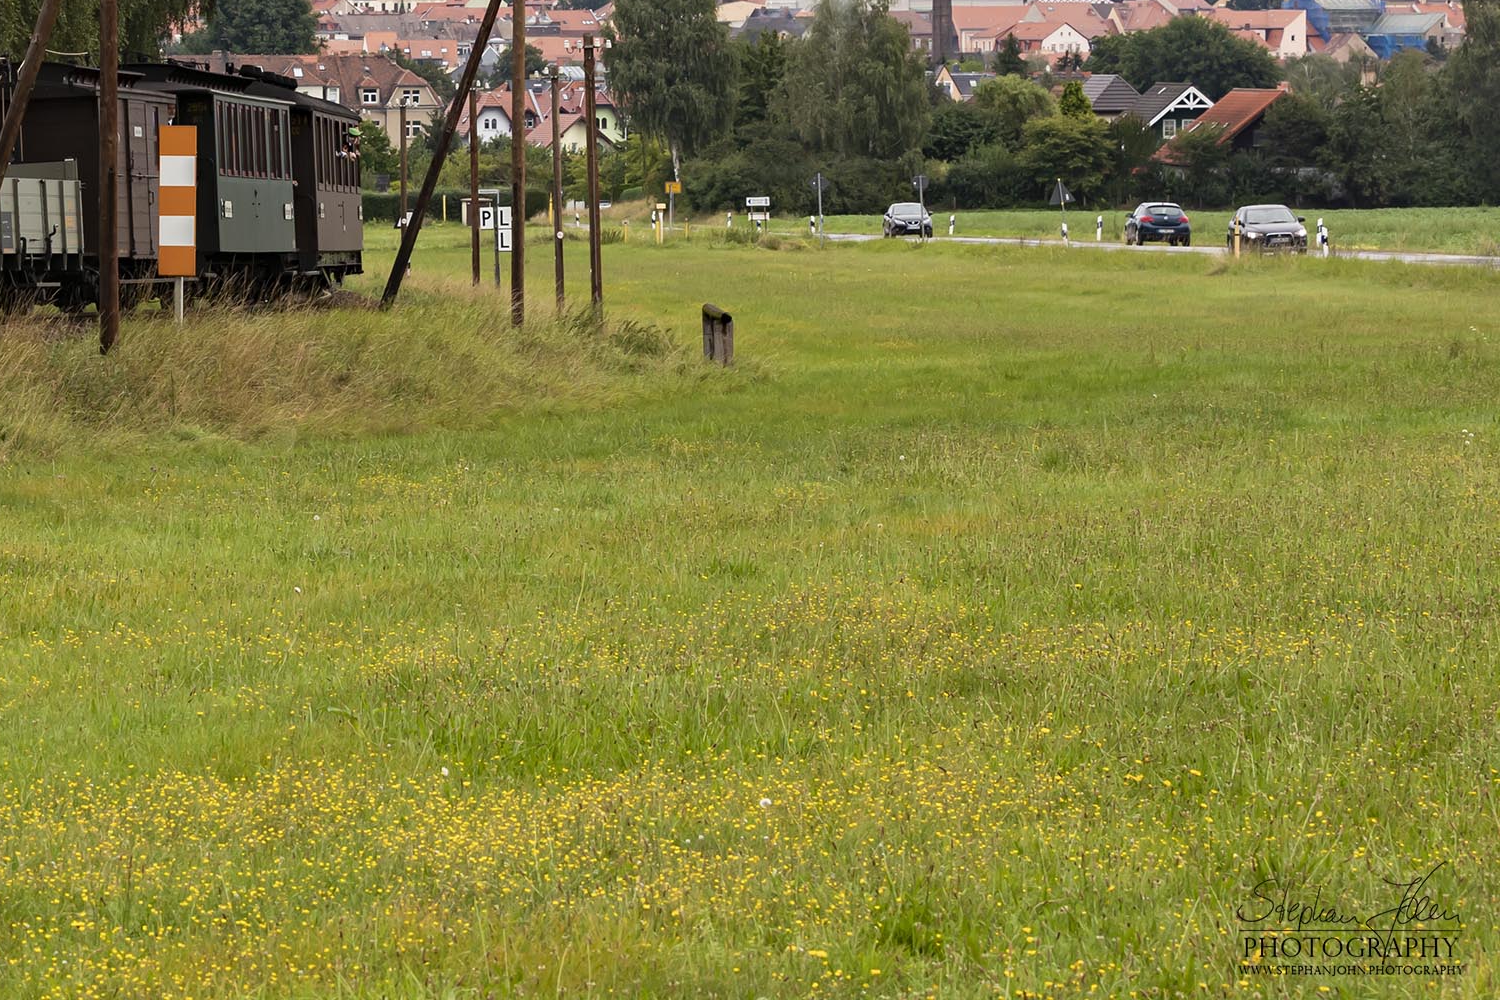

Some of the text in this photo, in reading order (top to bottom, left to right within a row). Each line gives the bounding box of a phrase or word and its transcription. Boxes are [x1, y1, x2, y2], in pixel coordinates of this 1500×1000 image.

[482, 210, 491, 227] P
[500, 210, 509, 226] L
[500, 232, 509, 248] L
